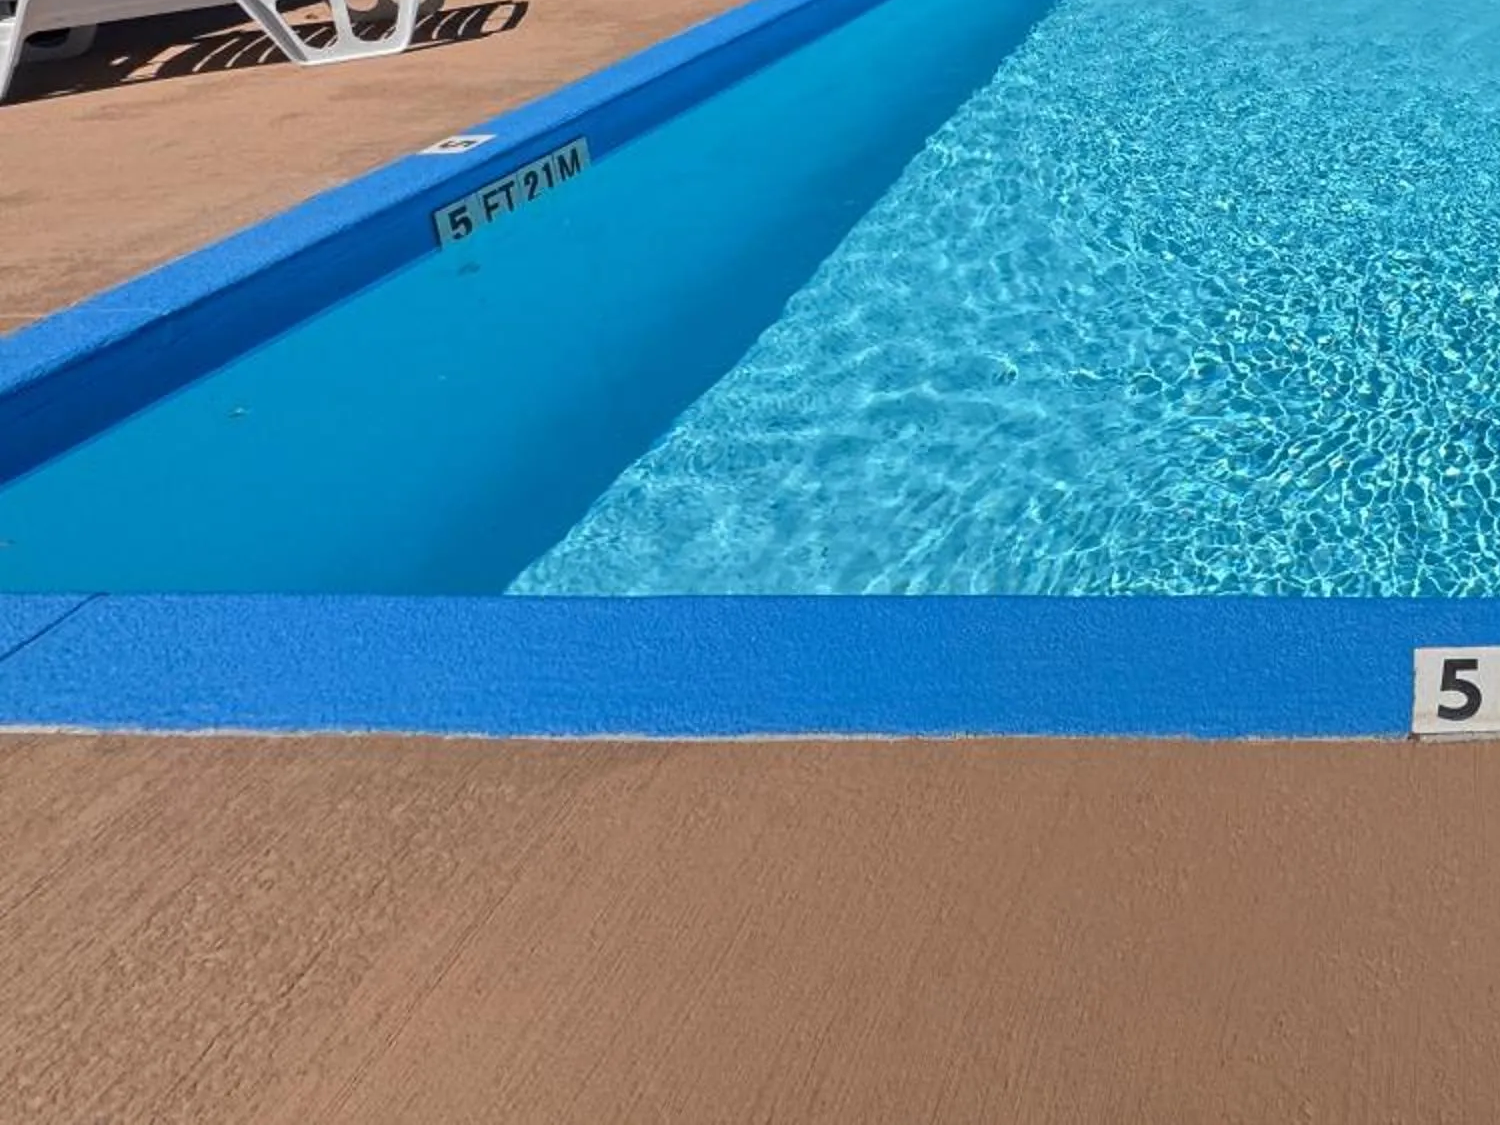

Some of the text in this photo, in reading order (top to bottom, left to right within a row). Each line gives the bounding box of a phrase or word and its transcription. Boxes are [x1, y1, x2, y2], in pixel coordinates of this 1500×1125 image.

[447, 204, 473, 240] 5
[482, 180, 515, 223] FT
[1437, 659, 1482, 721] 5
